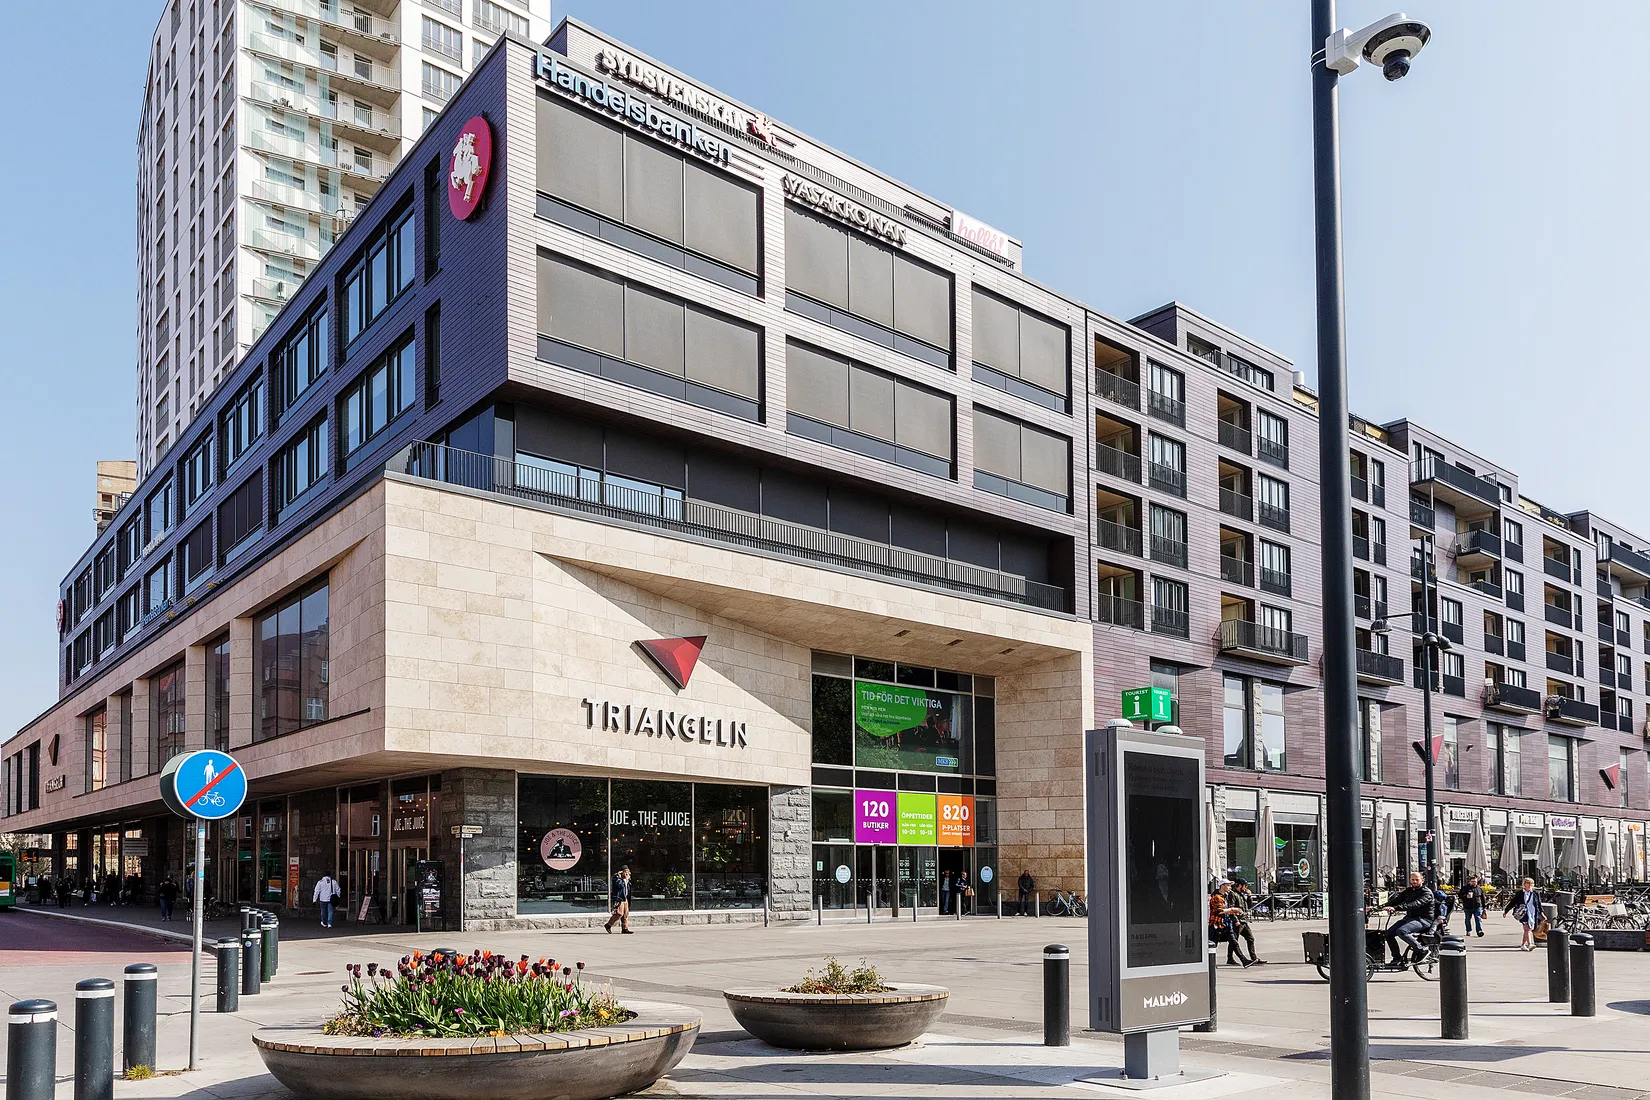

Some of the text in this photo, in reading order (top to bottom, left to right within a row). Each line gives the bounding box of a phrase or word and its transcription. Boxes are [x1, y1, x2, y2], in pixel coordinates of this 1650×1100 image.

[598, 47, 750, 132] SYDSVENSKAN
[535, 50, 733, 163] Handelsbanken
[783, 173, 908, 246] VASAKRONAN
[861, 690, 942, 709] TID FÖR DET VIKTIGA
[1133, 695, 1141, 716] i
[580, 698, 749, 749] TRIANGELN
[610, 809, 629, 825] JOE
[638, 810, 657, 826] THE
[661, 811, 690, 827] JUICE
[862, 800, 889, 818] 120
[901, 811, 933, 820] ÖPPETTIDER
[943, 804, 969, 821] 820
[404, 817, 412, 830] THE
[412, 816, 425, 830] JUICE
[863, 821, 889, 829] BUTIKER
[942, 824, 971, 832] P-PLATSER
[544, 834, 553, 846] JOE
[567, 833, 579, 846] JUICE
[1143, 990, 1180, 1009] MALMÖ
